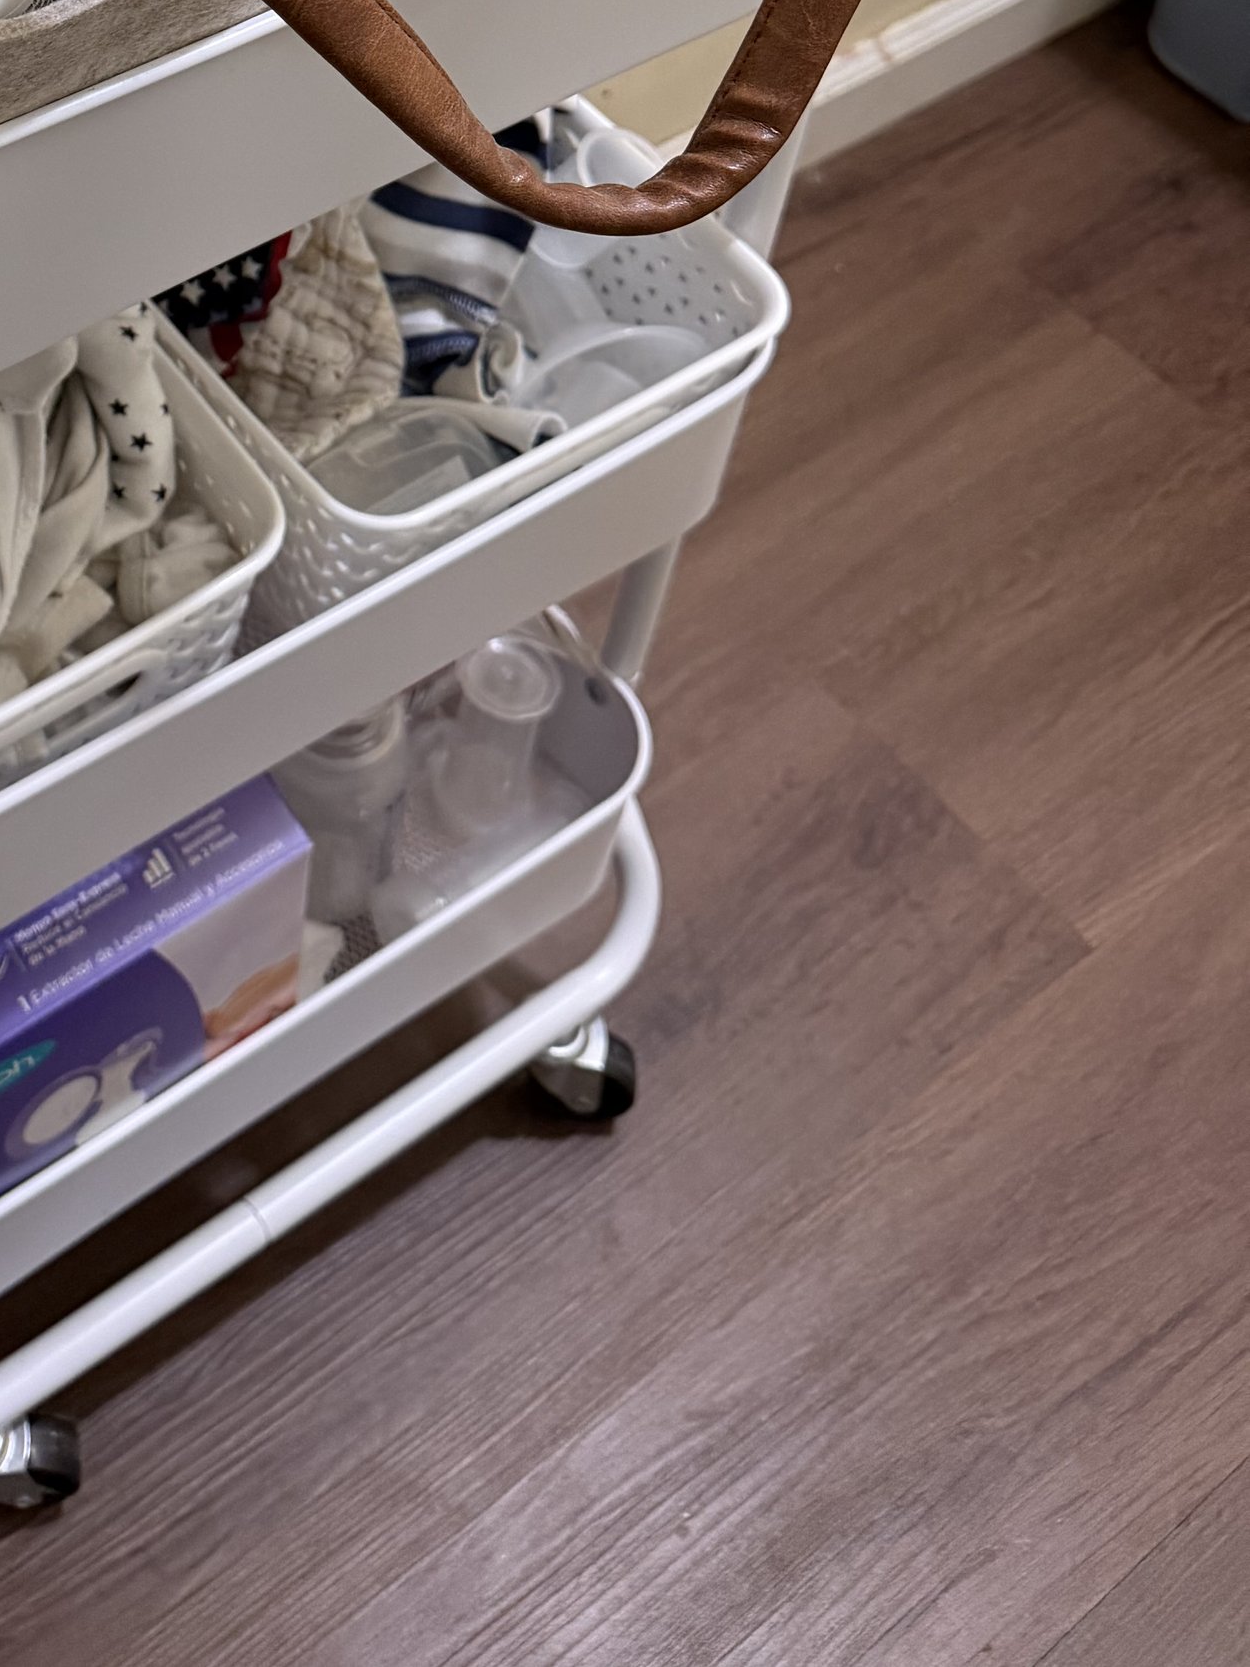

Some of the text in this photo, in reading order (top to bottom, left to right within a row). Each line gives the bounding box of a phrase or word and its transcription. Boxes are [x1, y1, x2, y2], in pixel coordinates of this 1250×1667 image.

[16, 993, 32, 1014] 1
[30, 958, 95, 1006] Extractor
[94, 945, 115, 964] de
[113, 919, 157, 951] Leche
[154, 887, 205, 925] Manual
